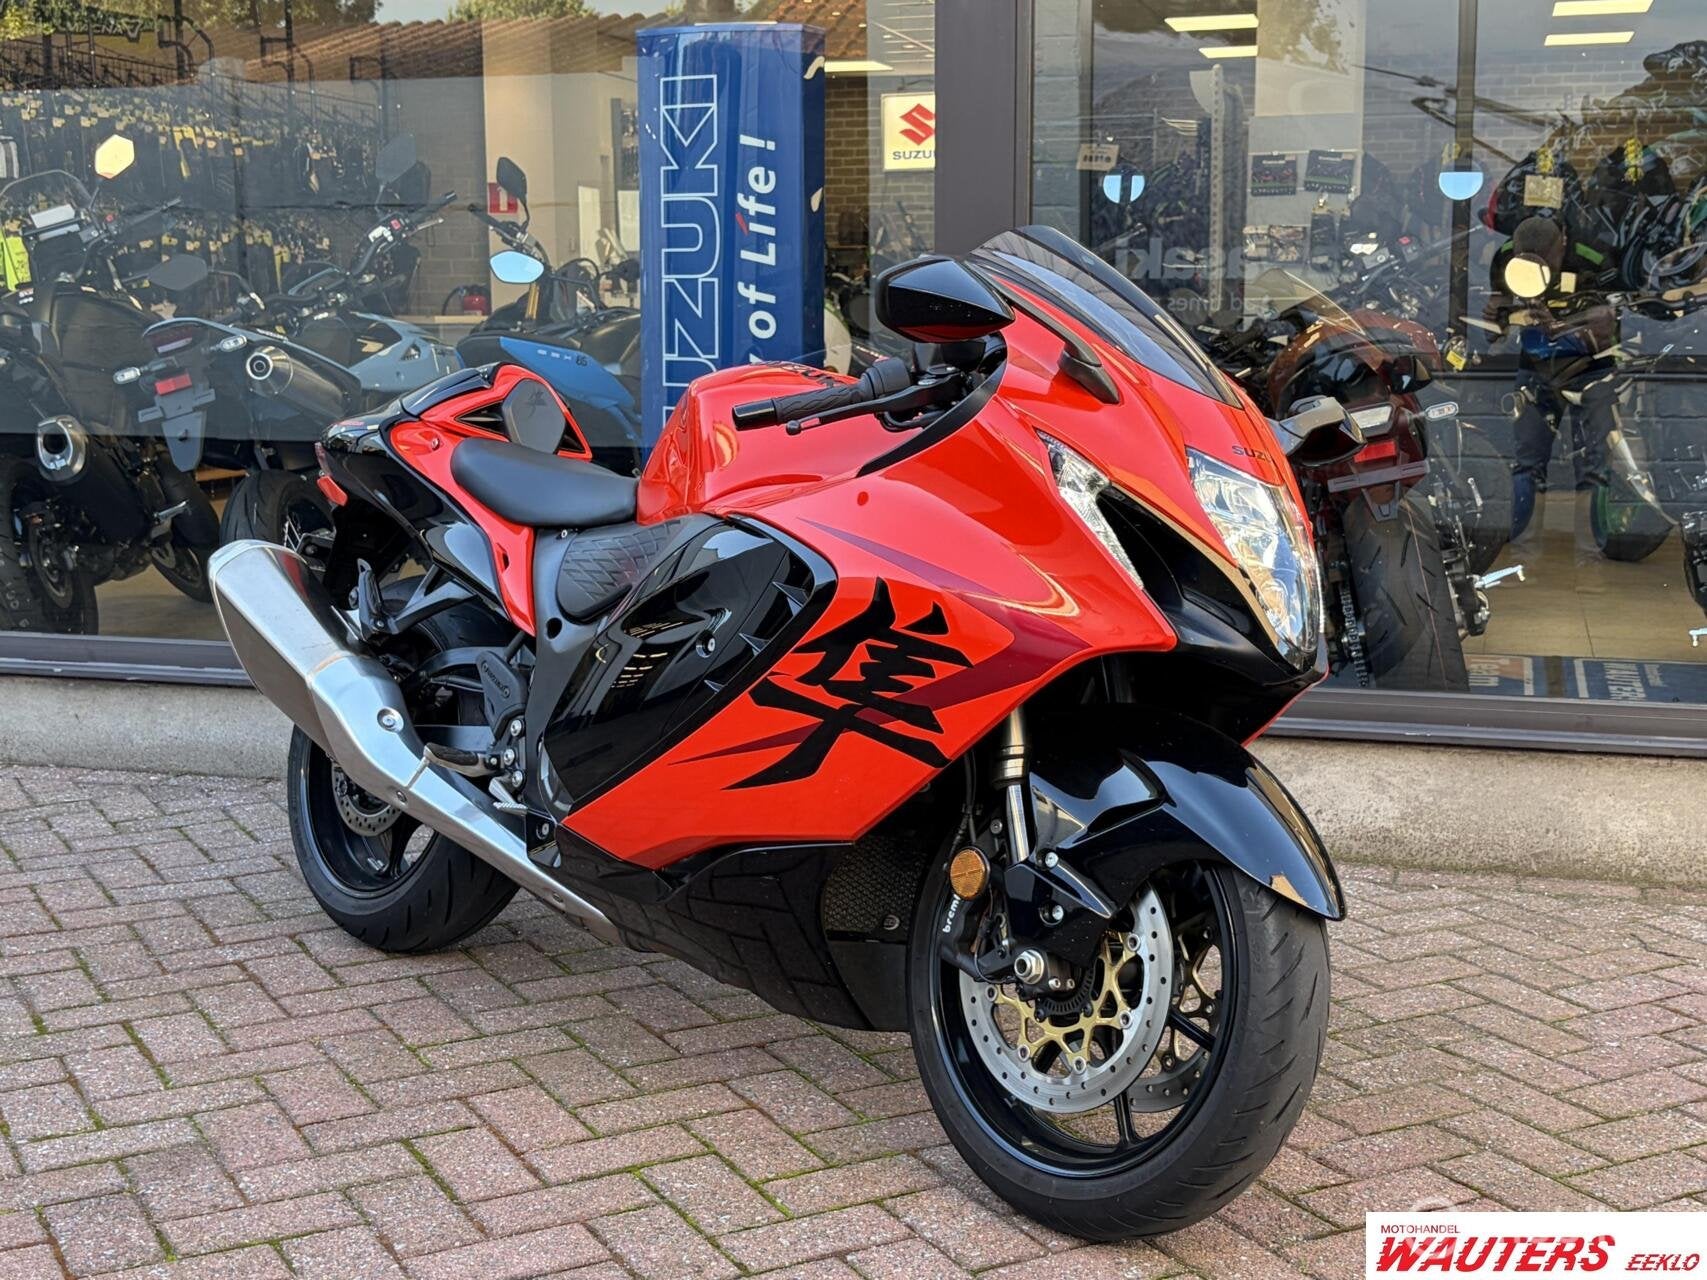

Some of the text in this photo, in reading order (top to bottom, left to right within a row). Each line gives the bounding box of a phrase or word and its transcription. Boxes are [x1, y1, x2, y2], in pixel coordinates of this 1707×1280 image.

[892, 150, 936, 161] SUZU
[660, 74, 721, 428] UZUKI
[737, 281, 776, 339] of
[1231, 445, 1272, 463] SUZ
[1469, 658, 1510, 687] Team
